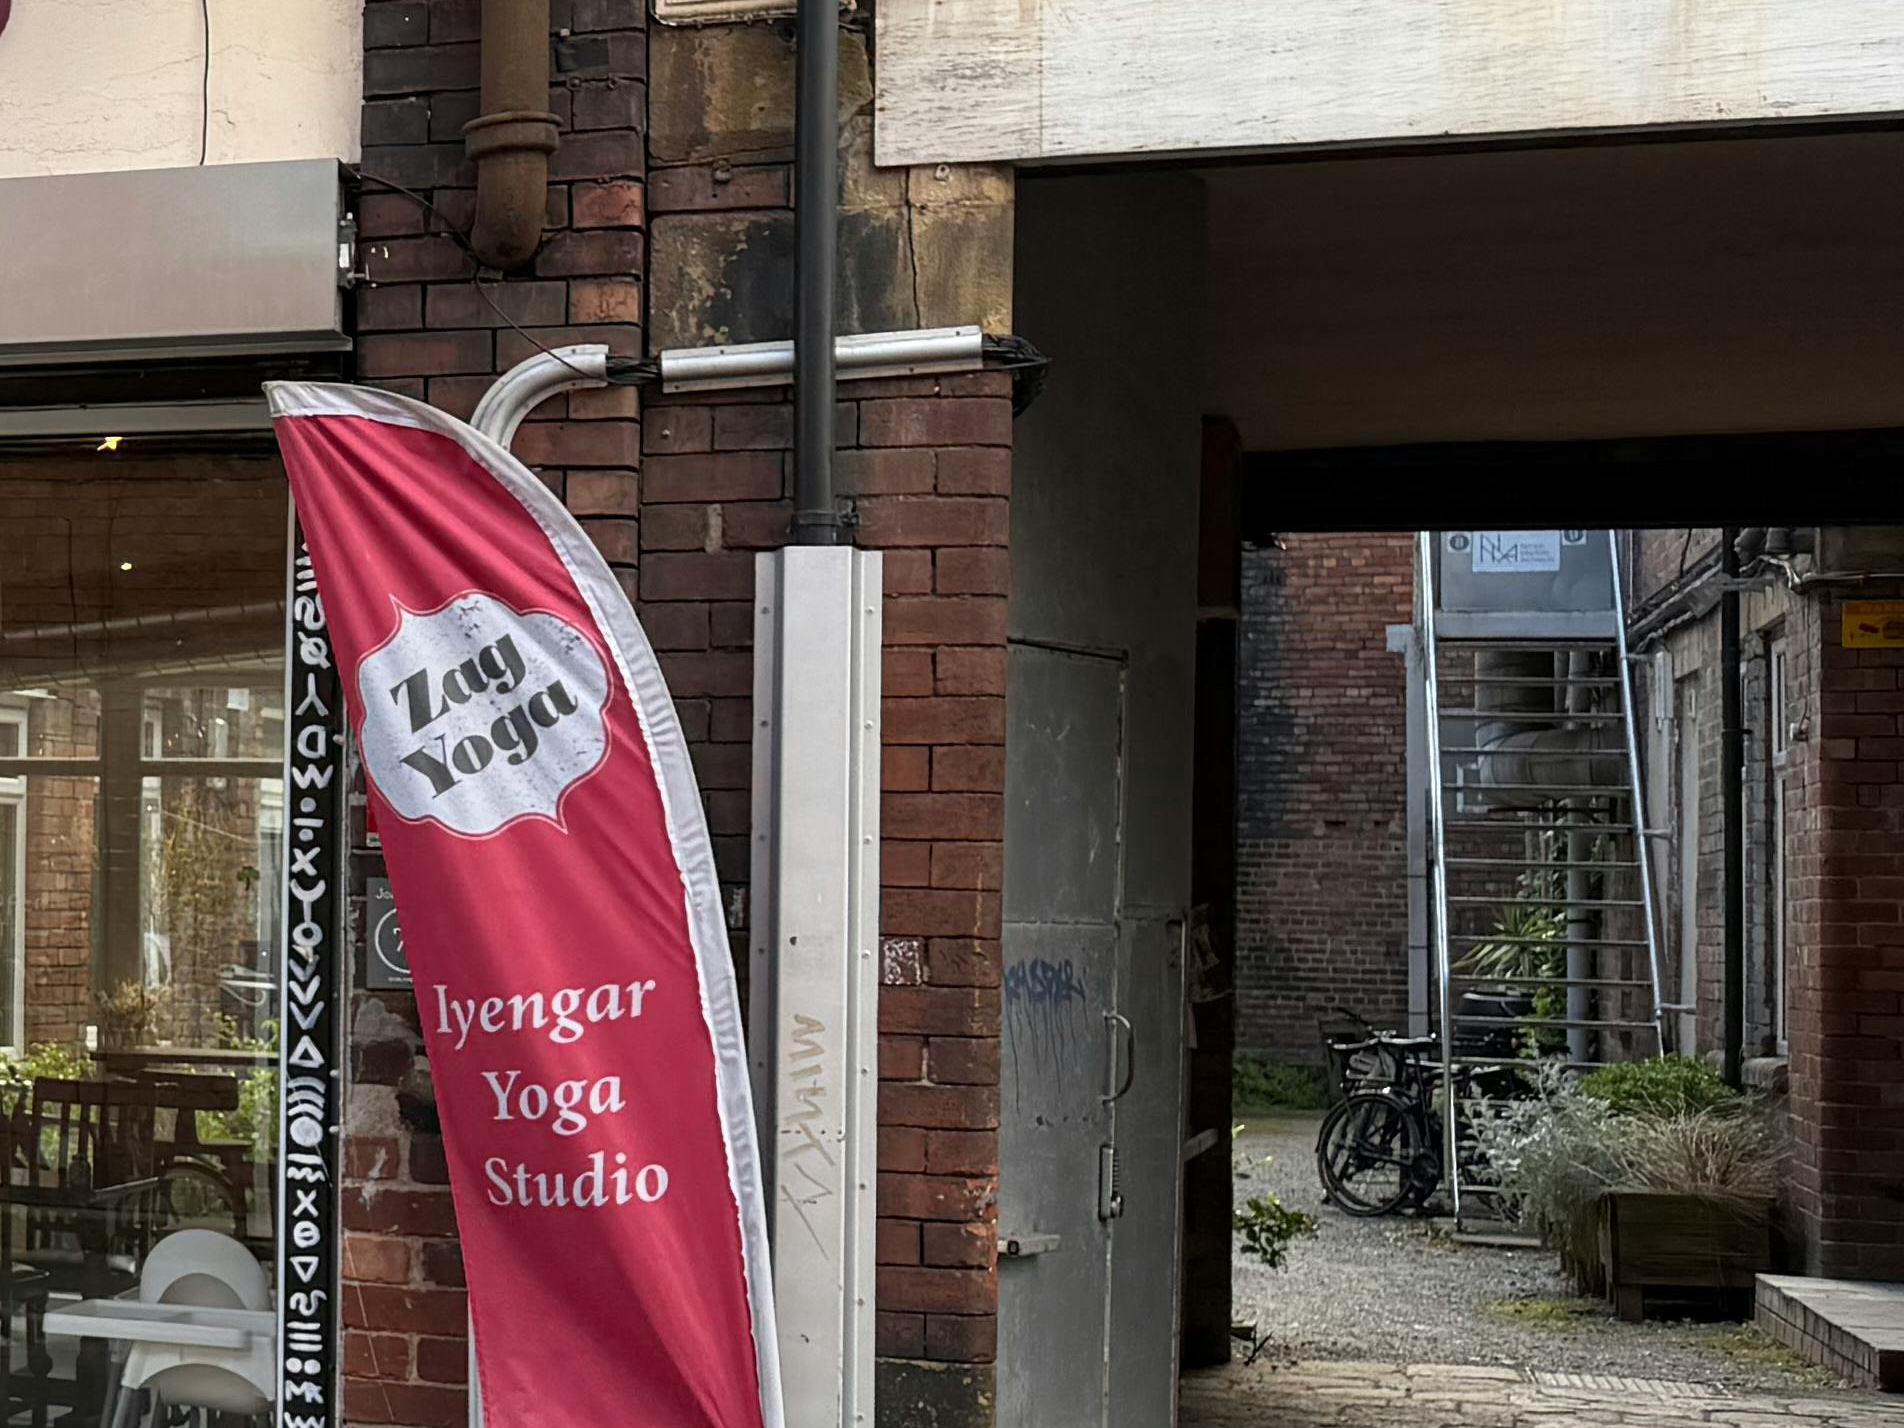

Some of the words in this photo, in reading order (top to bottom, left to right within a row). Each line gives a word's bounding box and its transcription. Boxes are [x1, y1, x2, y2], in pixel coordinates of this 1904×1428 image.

[388, 632, 527, 734] Zag
[399, 679, 579, 800] Yoga
[432, 979, 657, 1050] Iyengar
[481, 1070, 626, 1136] Yoga
[485, 1151, 669, 1208] Studio
